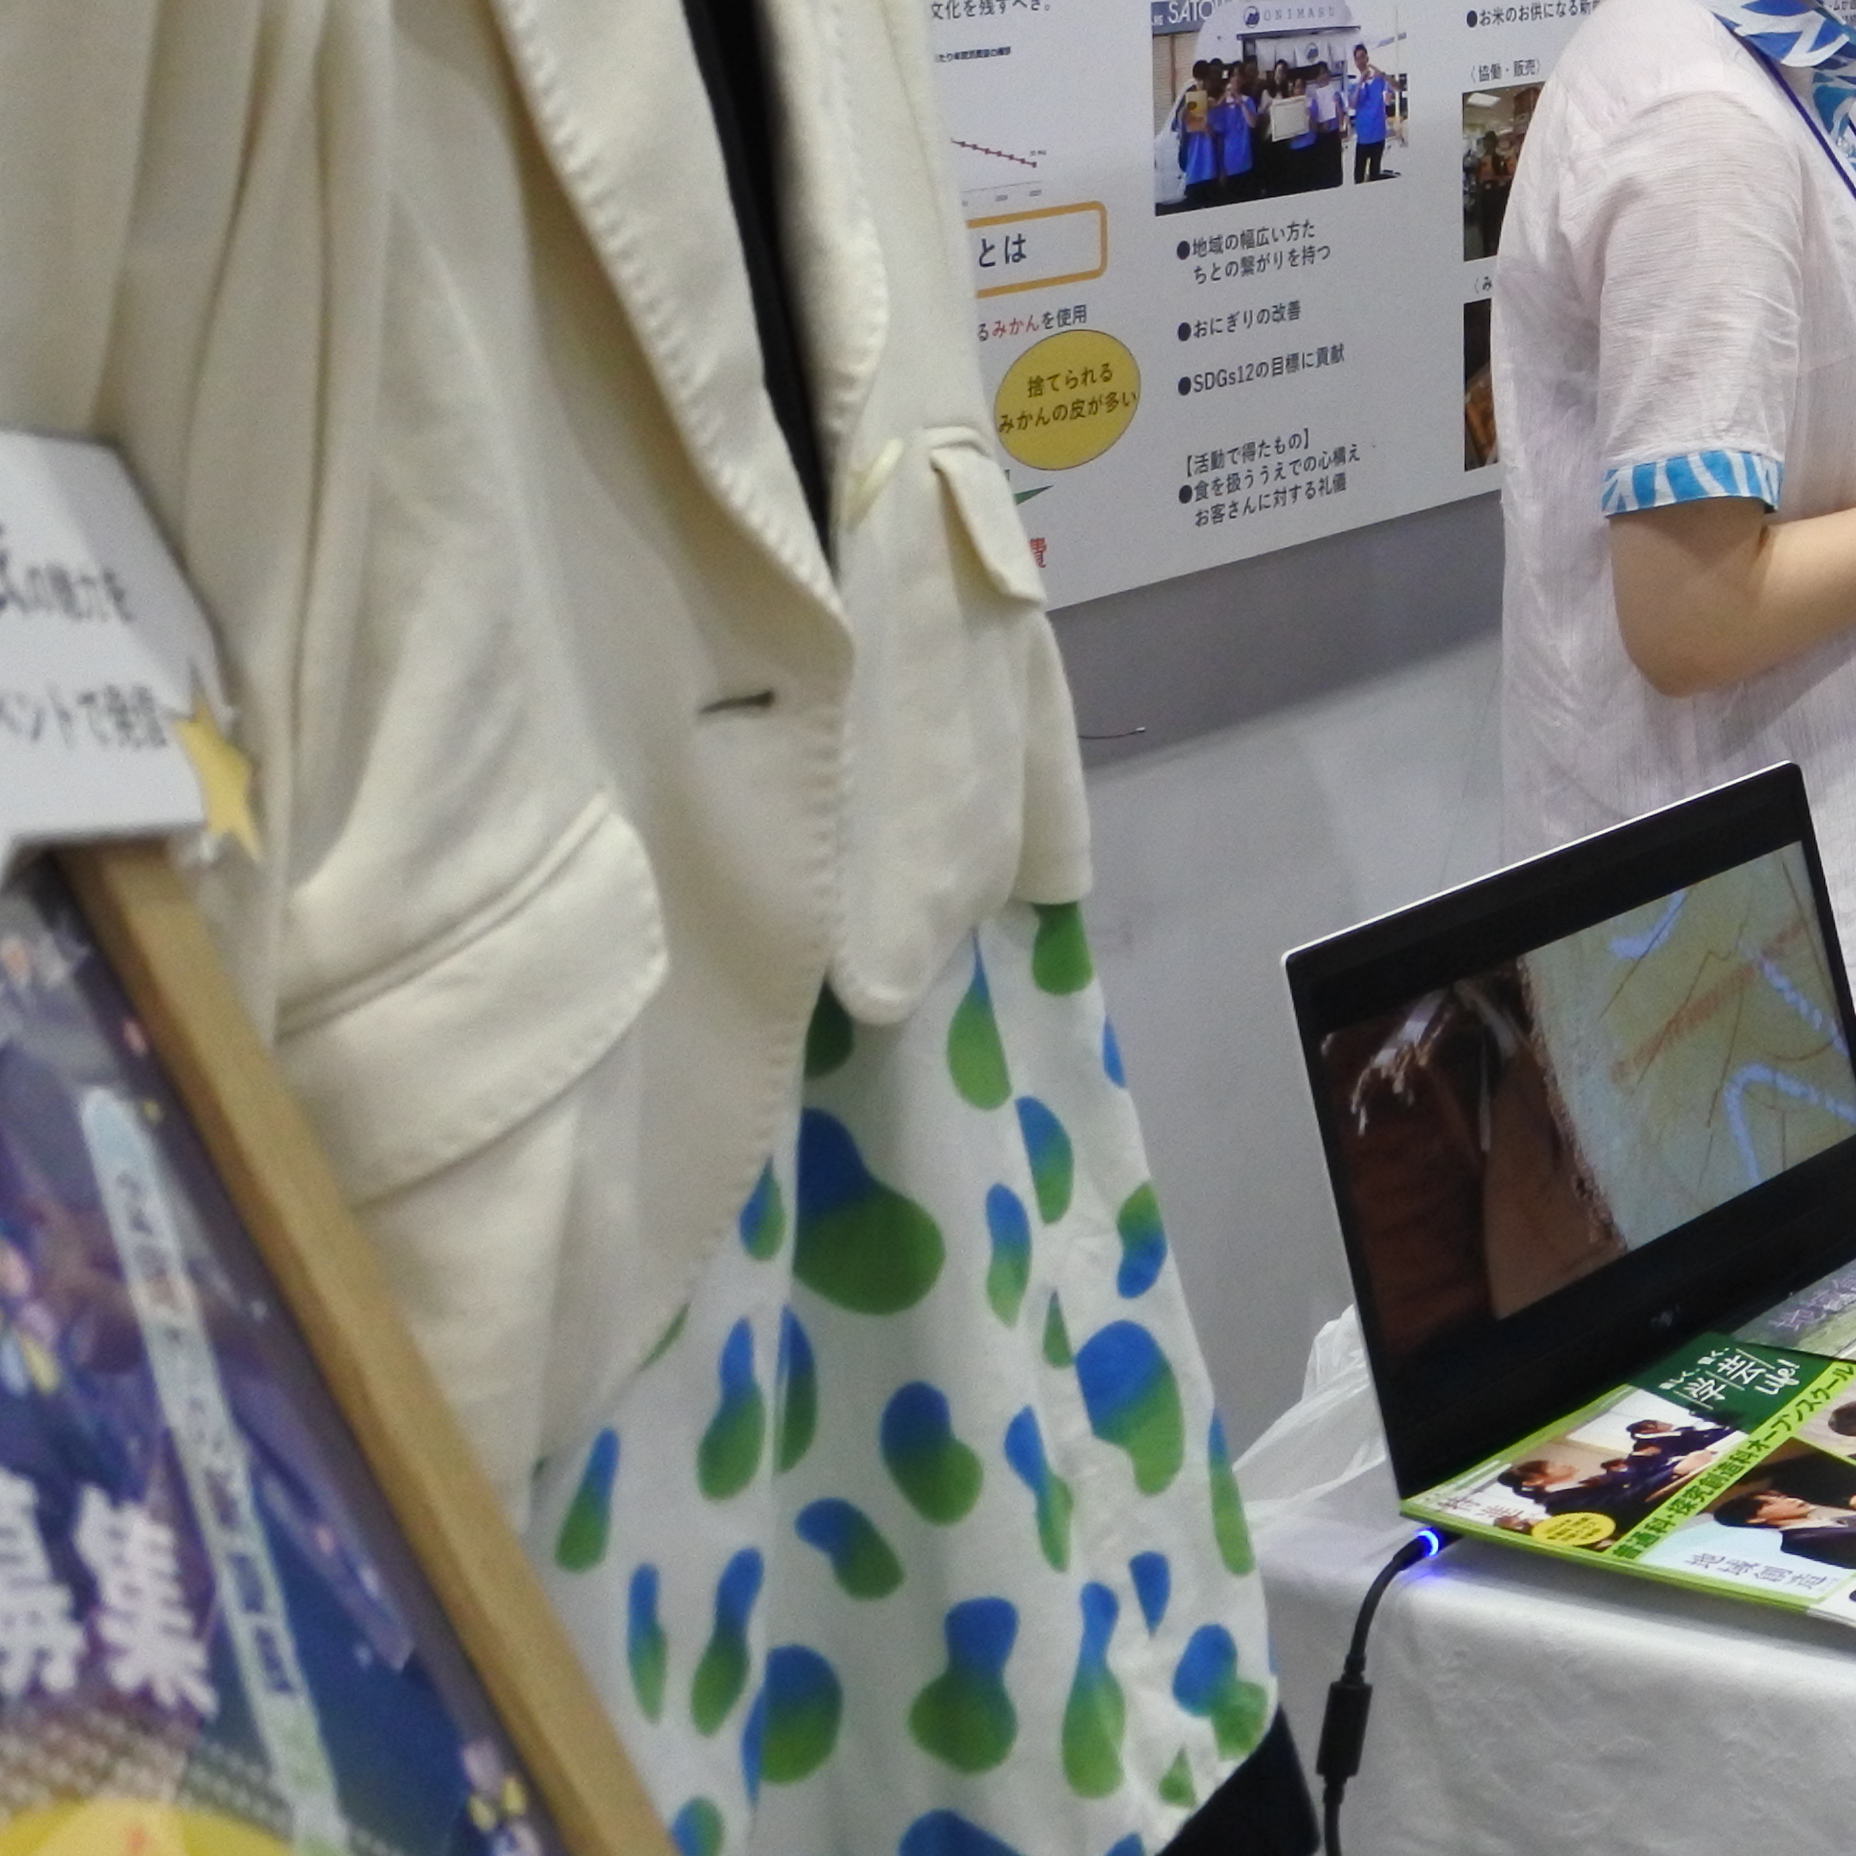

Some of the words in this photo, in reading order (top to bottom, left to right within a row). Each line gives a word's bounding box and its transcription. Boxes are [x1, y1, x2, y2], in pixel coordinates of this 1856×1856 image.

[1026, 362, 1113, 399] 捨てられる
